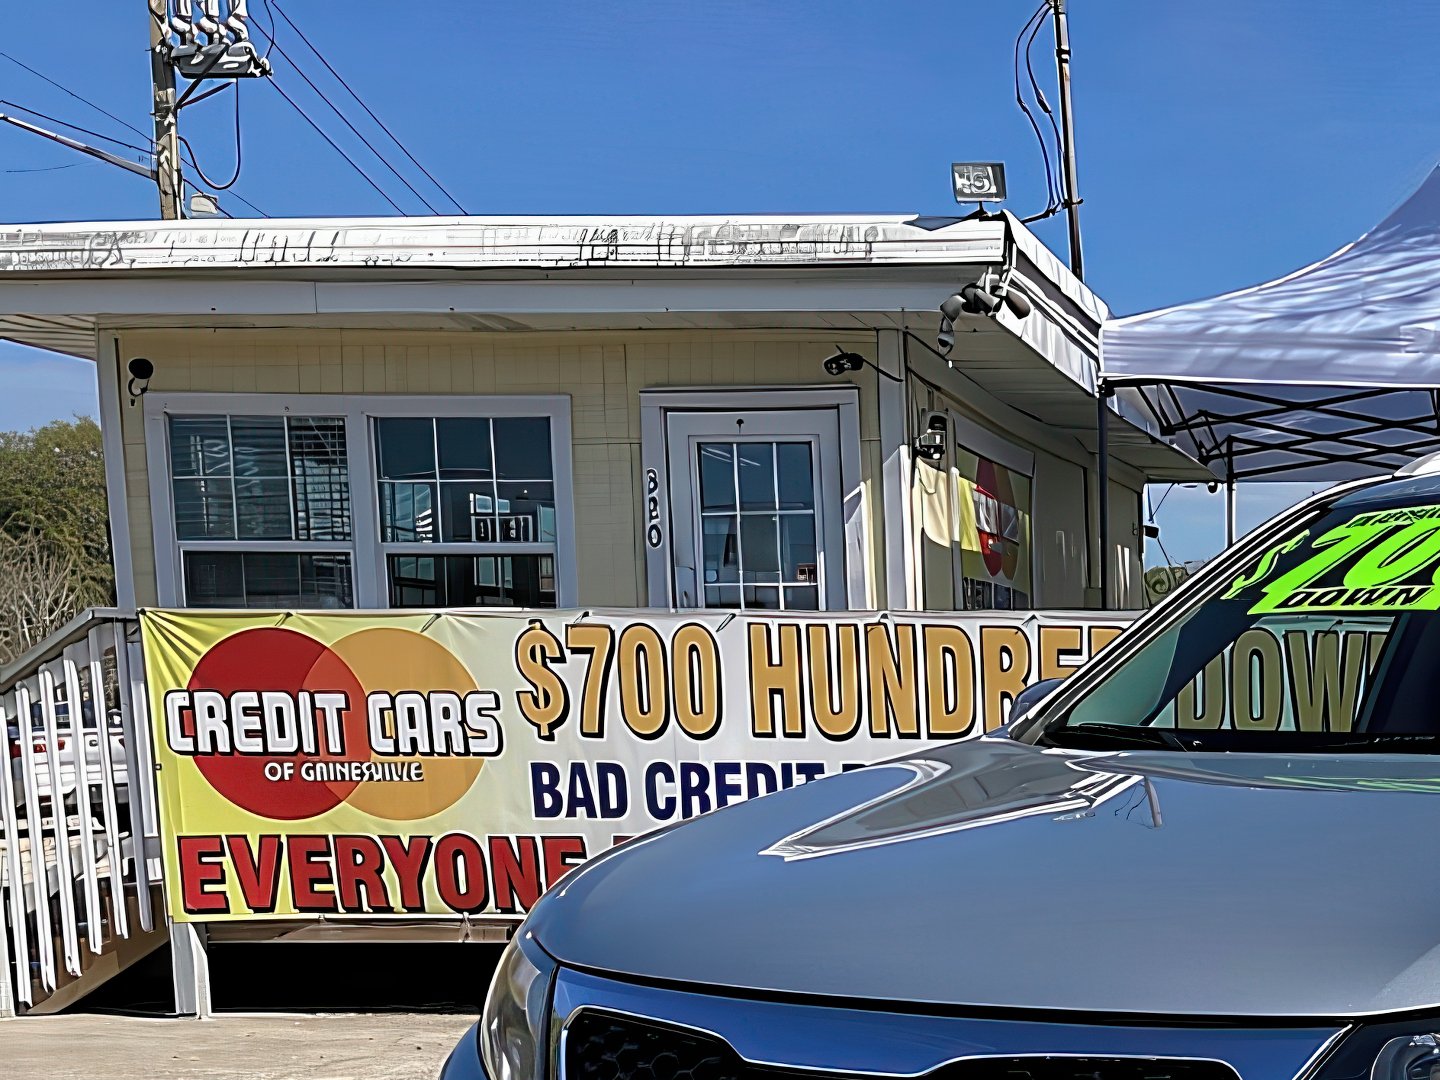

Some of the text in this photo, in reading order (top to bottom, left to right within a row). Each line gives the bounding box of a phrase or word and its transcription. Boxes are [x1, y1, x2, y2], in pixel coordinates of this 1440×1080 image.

[1273, 586, 1432, 609] DOWN
[516, 618, 1388, 741] $700 HUNDRE DOW
[164, 689, 504, 757] CREDIT CARS
[264, 761, 295, 782] OF
[530, 762, 628, 820] BAD
[179, 835, 588, 915] EVERYONE
